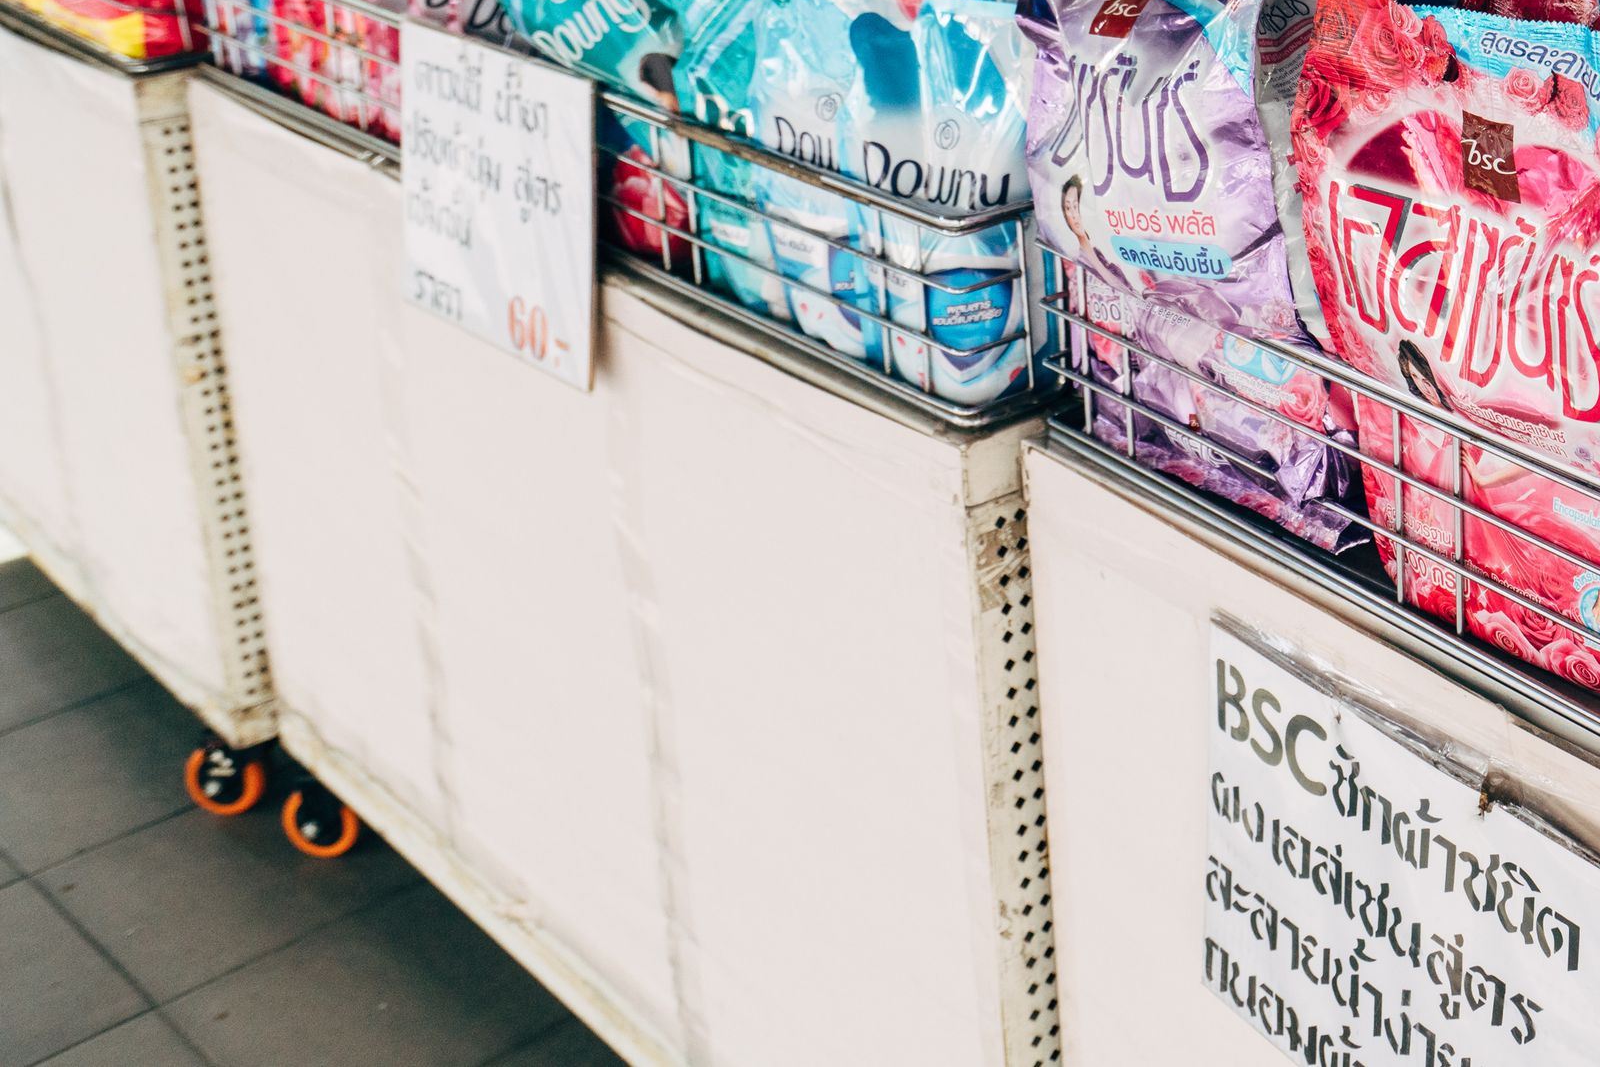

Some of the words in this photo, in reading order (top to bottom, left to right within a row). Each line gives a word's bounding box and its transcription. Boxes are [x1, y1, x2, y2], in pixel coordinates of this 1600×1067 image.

[1461, 139, 1517, 175] bsc
[1106, 208, 1160, 235] ซูเปอร์
[1168, 211, 1216, 236] พลัส
[1119, 244, 1225, 276] ลดกลิ่นอับชื้น
[1150, 305, 1191, 327] etergent
[1385, 504, 1453, 547] สูรมาตรฐาน
[1431, 567, 1471, 599] กรม
[1215, 657, 1328, 797] BSC
